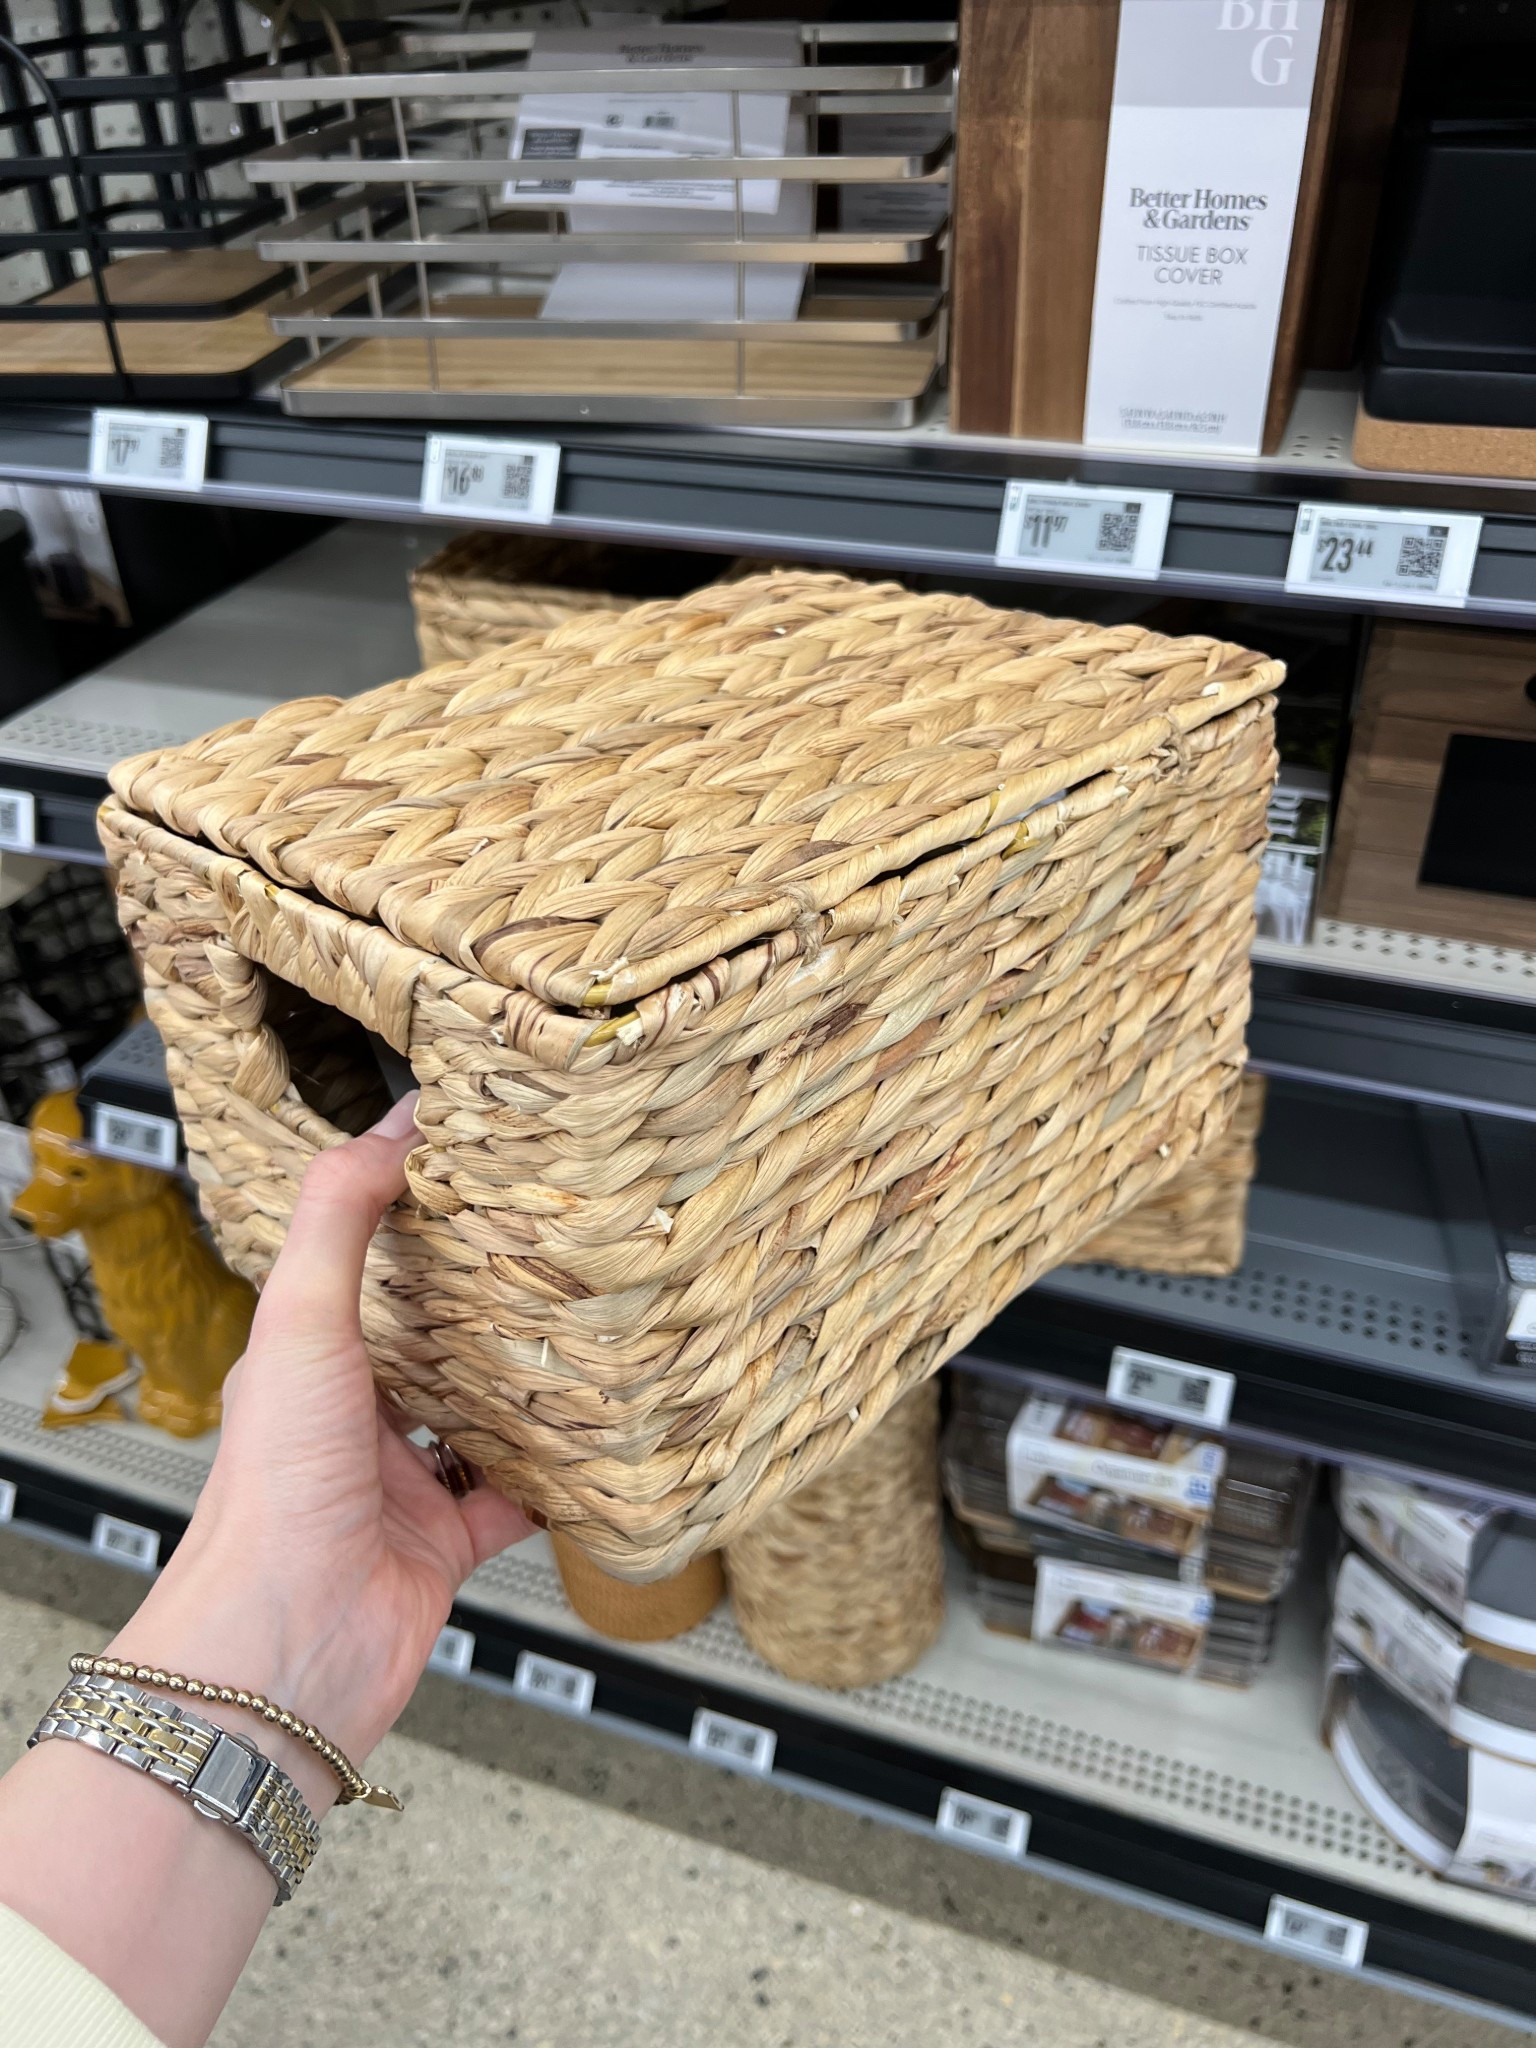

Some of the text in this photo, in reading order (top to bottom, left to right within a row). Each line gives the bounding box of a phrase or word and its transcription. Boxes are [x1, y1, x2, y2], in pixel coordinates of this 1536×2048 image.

[1217, 0, 1299, 30] BH
[1250, 34, 1295, 87] G
[1130, 187, 1268, 211] Better Homes
[1137, 245, 1249, 265] TISSUE BOX
[1154, 267, 1223, 285] COVER
